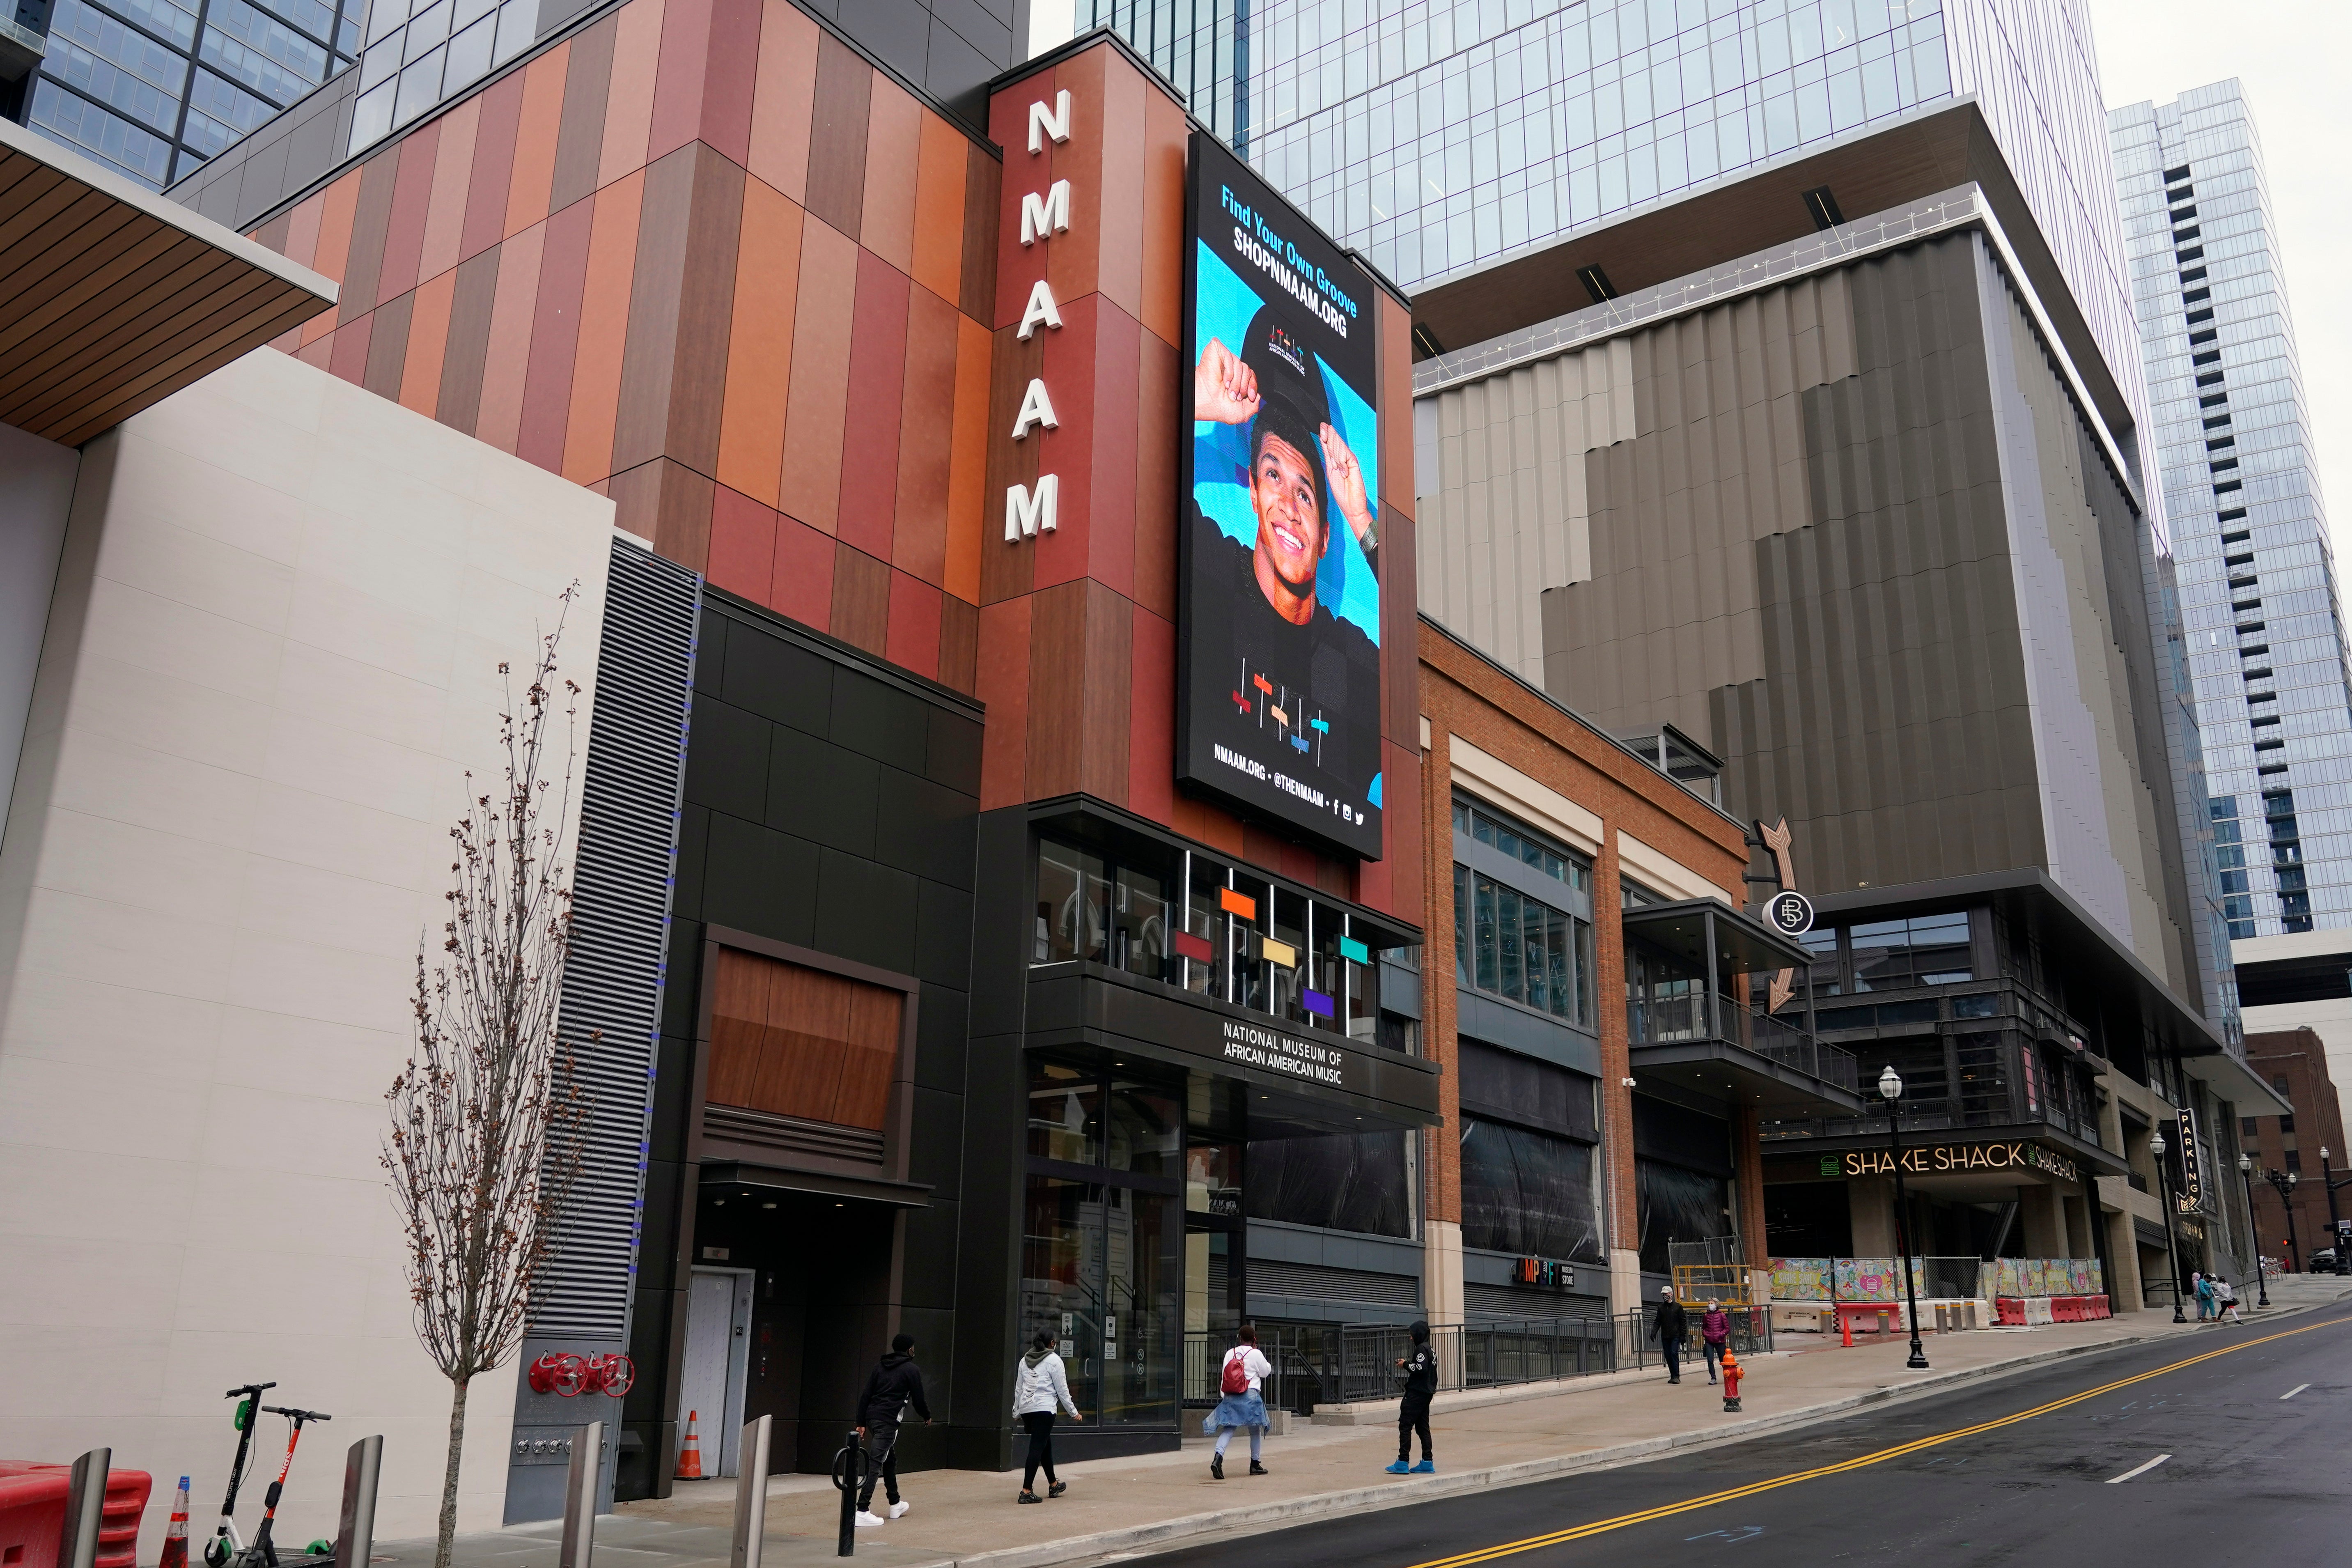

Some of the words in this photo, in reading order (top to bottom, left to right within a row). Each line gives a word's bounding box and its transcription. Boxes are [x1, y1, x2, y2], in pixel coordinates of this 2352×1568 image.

[1222, 184, 1251, 229] Find
[1254, 211, 1284, 255] Your
[1286, 241, 1313, 282] Own
[1316, 267, 1357, 318] Groove
[1234, 226, 1347, 338] SHOPNMAAM.ORG
[1005, 89, 1070, 543] NMAAM
[1214, 743, 1265, 781] NMAAM.ORG
[1274, 772, 1324, 808] @THENMAAM
[1224, 1022, 1278, 1050] NATIONAL
[1283, 1038, 1326, 1063] MUSEUM
[1329, 1051, 1342, 1066] OF
[1224, 1042, 1265, 1065] AFRICAN
[1267, 1053, 1314, 1077] AMERICAN
[1315, 1065, 1342, 1085] MUSIC
[1846, 1149, 1930, 1175] SHAKE
[1934, 1143, 2026, 1170] SHACK
[2035, 1146, 2058, 1175] SHAKE
[2057, 1155, 2078, 1183] SHACK
[2181, 1115, 2198, 1193] PARKING
[1562, 1275, 1574, 1285] STORE
[1778, 1272, 1797, 1283] SHAKE
[1799, 1273, 1817, 1284] SHACK
[279, 1451, 292, 1477] SPIN
